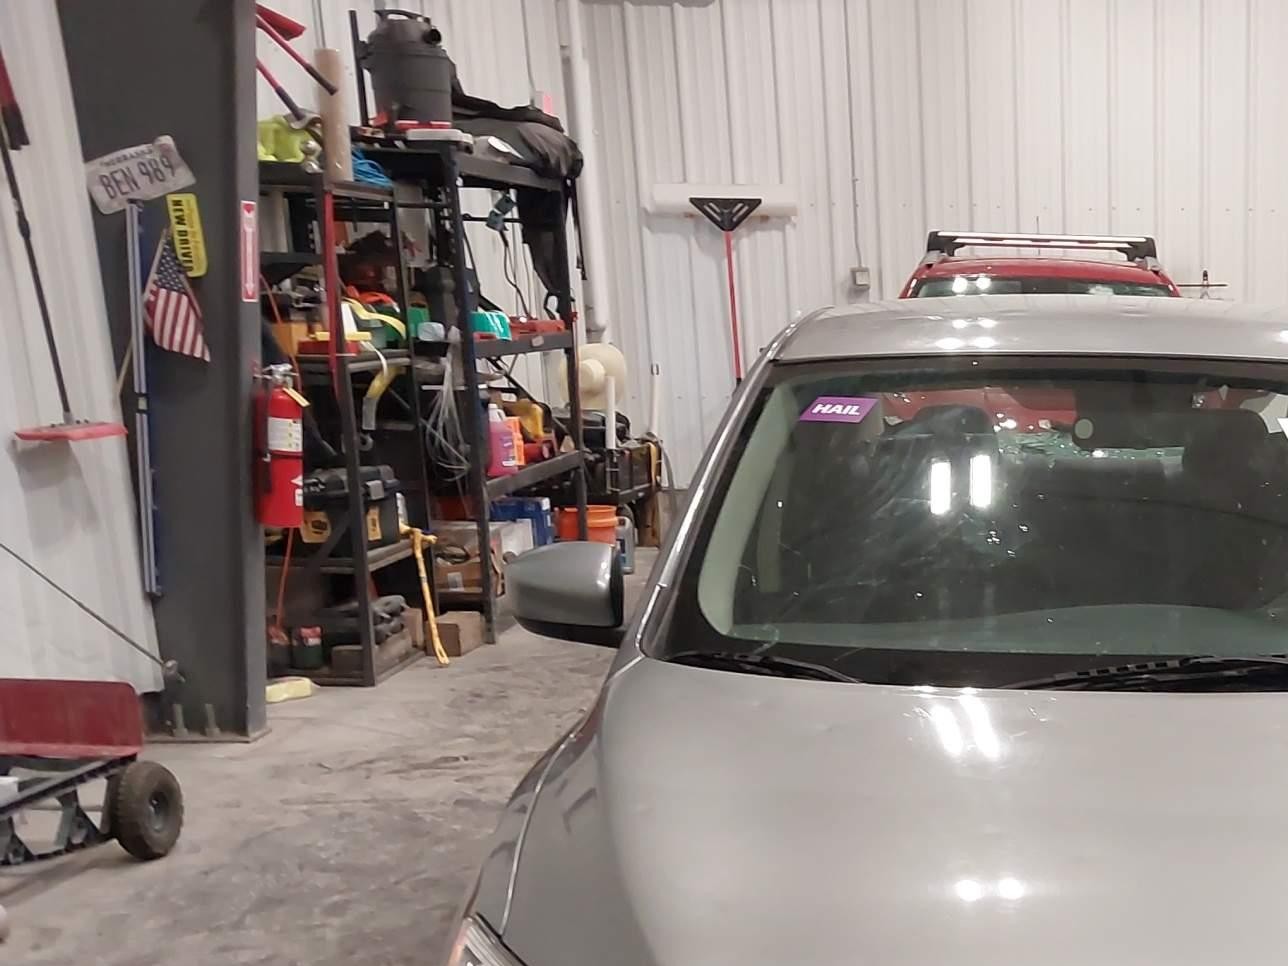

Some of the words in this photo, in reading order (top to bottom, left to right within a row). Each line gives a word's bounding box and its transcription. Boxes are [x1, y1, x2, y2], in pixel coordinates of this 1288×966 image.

[99, 166, 140, 199] BEN
[137, 155, 175, 183] 989
[172, 199, 186, 226] NEW
[812, 404, 860, 415] HAIL
